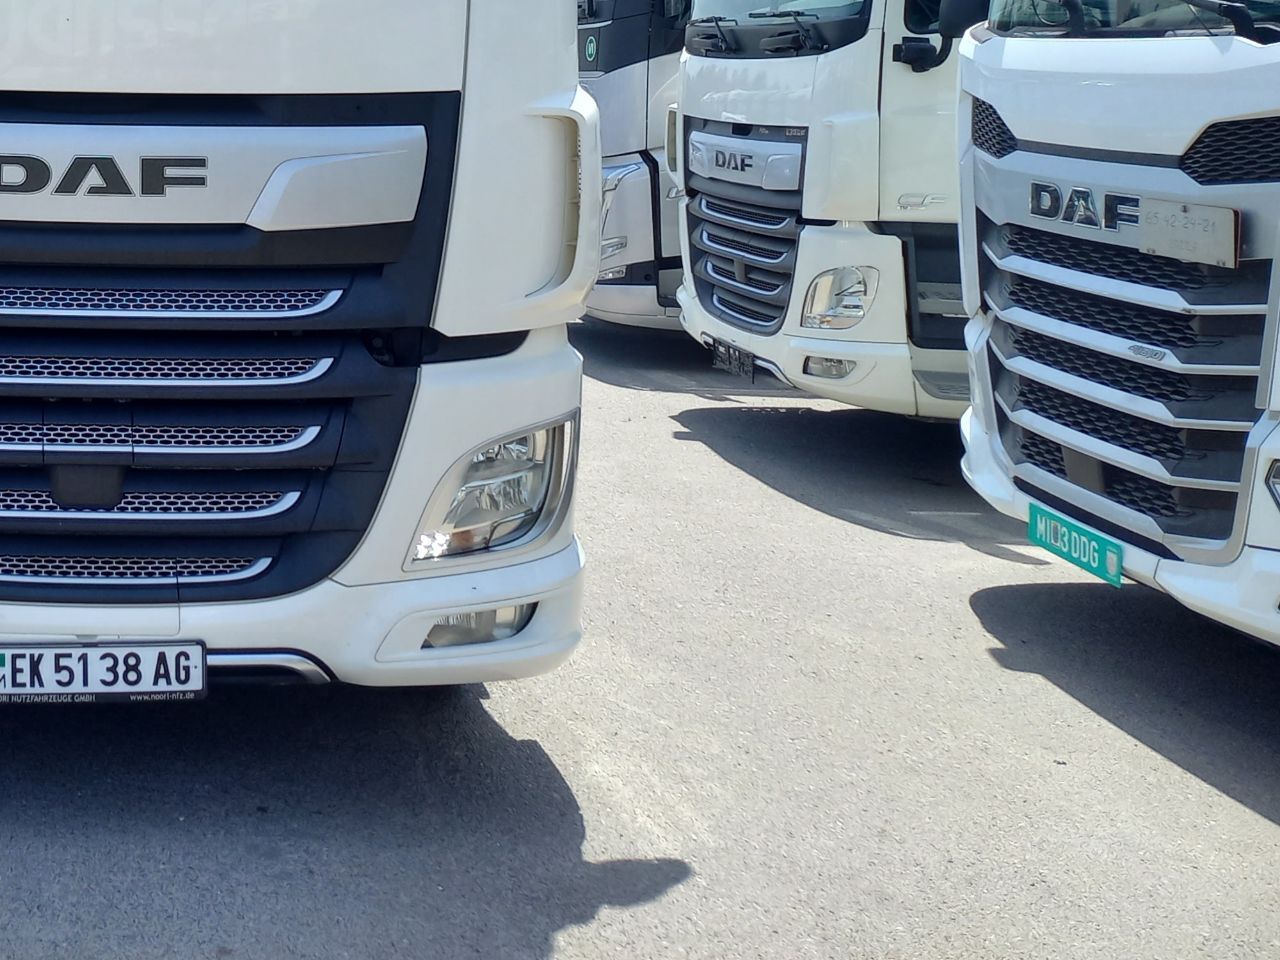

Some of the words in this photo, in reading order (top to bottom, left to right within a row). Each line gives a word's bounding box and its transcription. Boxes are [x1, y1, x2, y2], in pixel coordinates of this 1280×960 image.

[715, 149, 754, 172] DAF
[1029, 180, 1142, 232] DAF
[11, 653, 45, 688] EK
[54, 652, 143, 688] 5138
[152, 651, 191, 686] AG
[129, 692, 195, 701] www.noori-nfz.de
